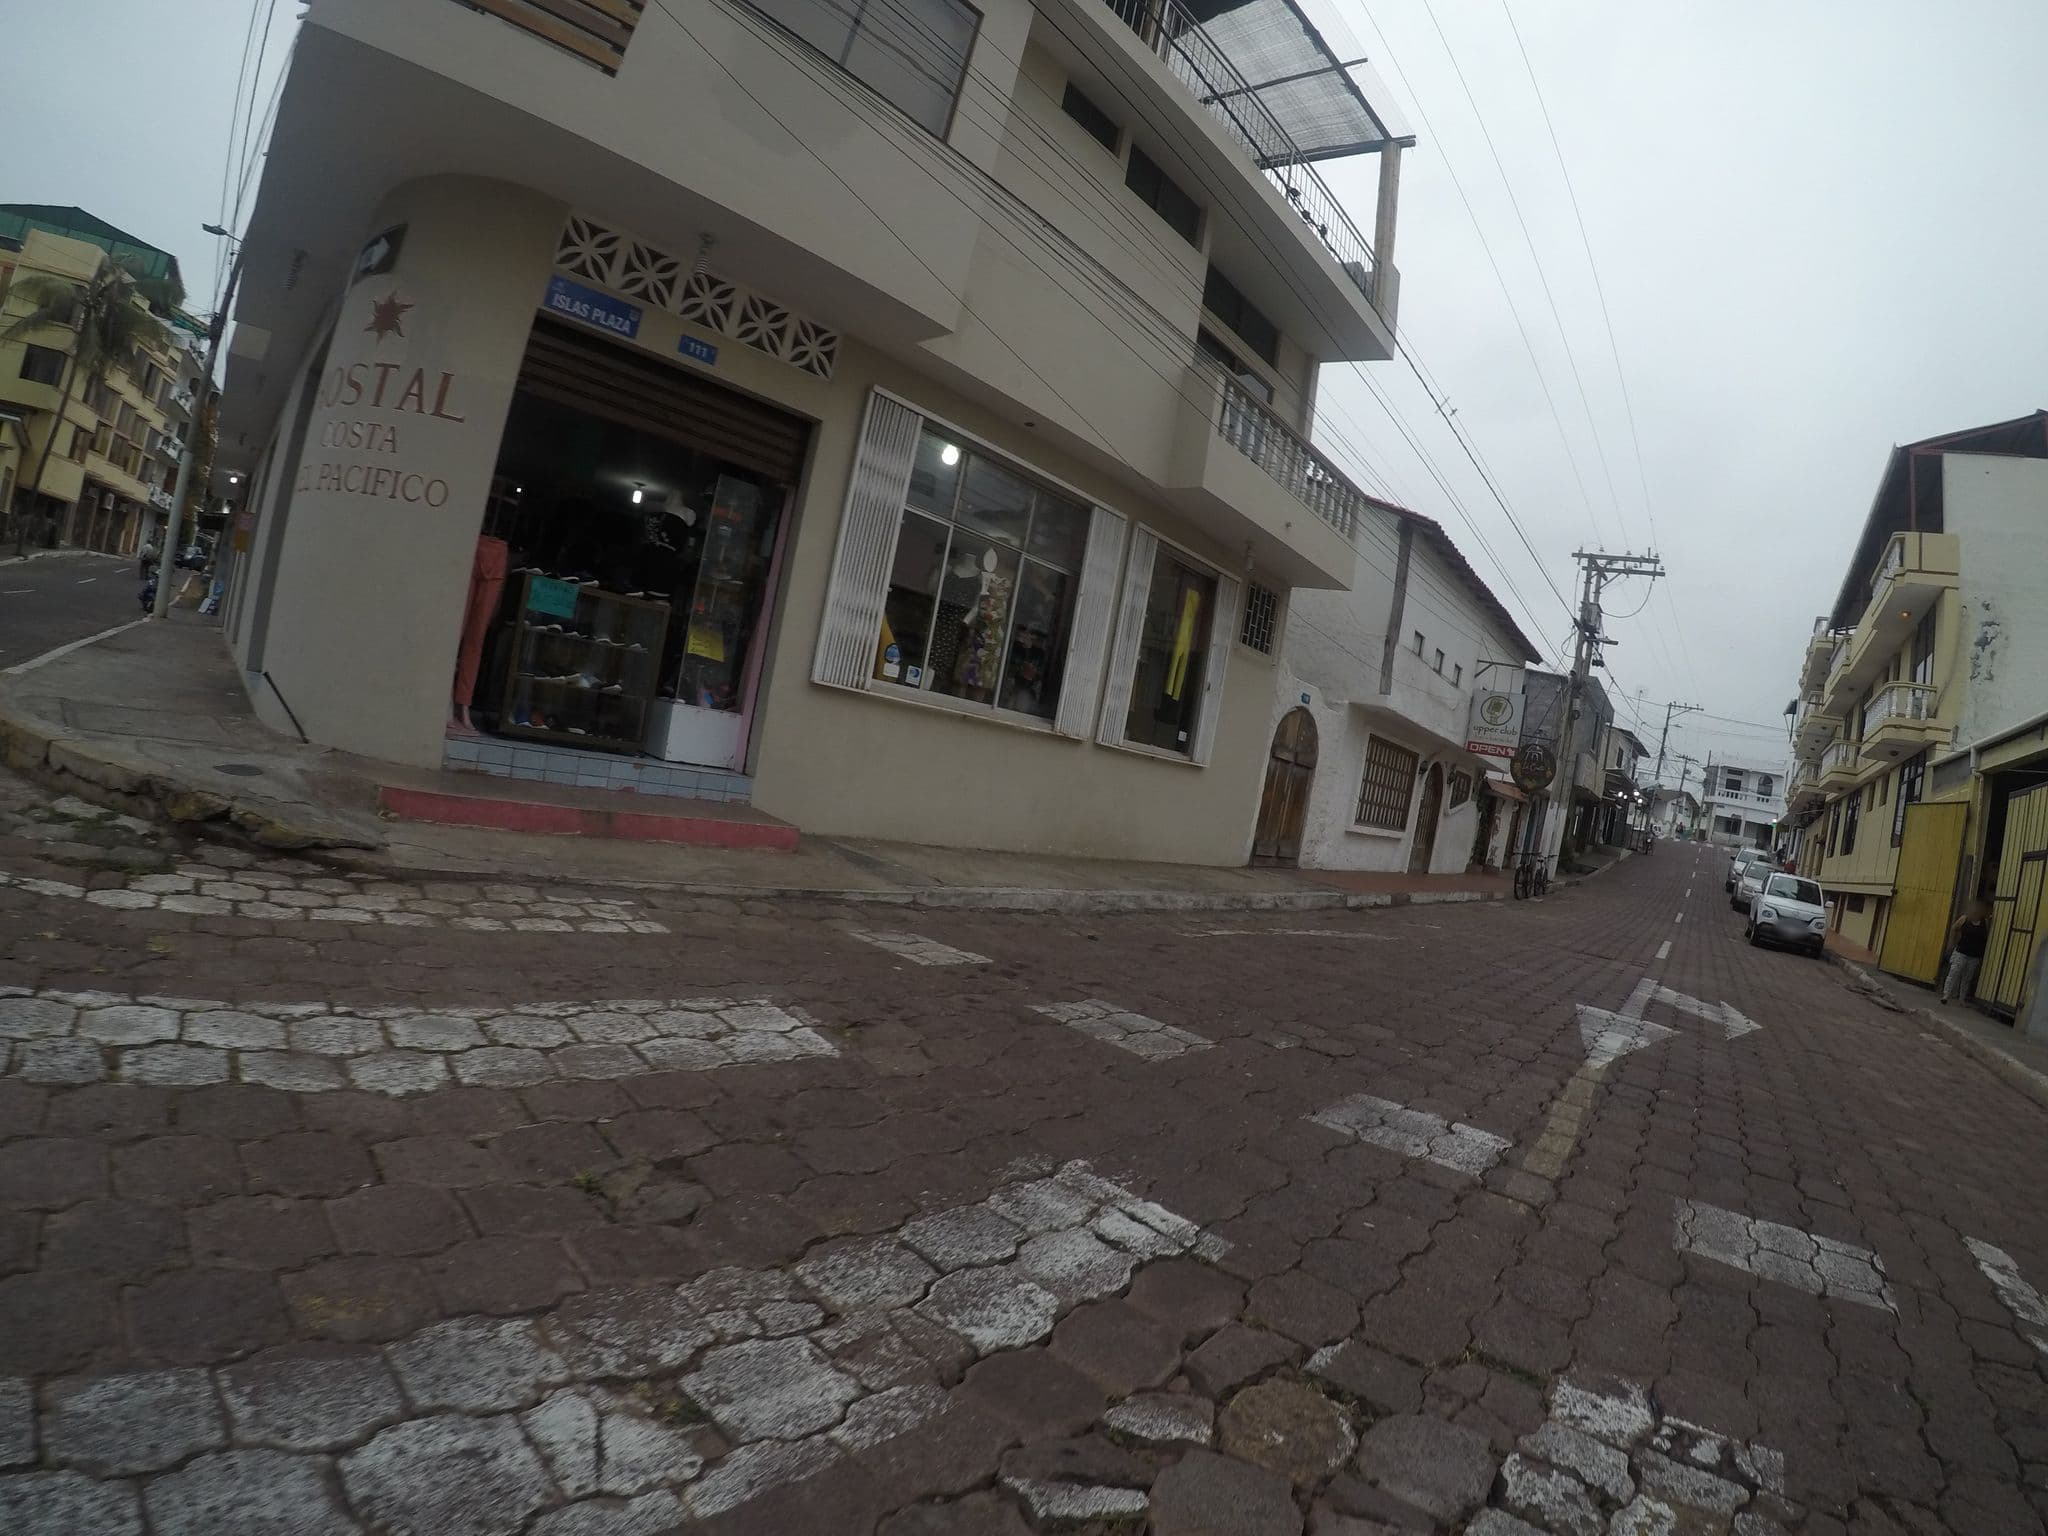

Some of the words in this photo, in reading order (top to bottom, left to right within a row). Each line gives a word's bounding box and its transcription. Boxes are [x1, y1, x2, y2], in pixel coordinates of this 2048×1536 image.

[551, 293, 590, 317] ISLAS
[592, 308, 631, 334] PLAZA
[319, 363, 465, 423] OSTAL
[320, 421, 397, 453] COSTA
[316, 463, 448, 507] PACIFICO
[1473, 725, 1499, 736] upper
[1500, 724, 1518, 736] club
[1470, 743, 1506, 755] OPEN
